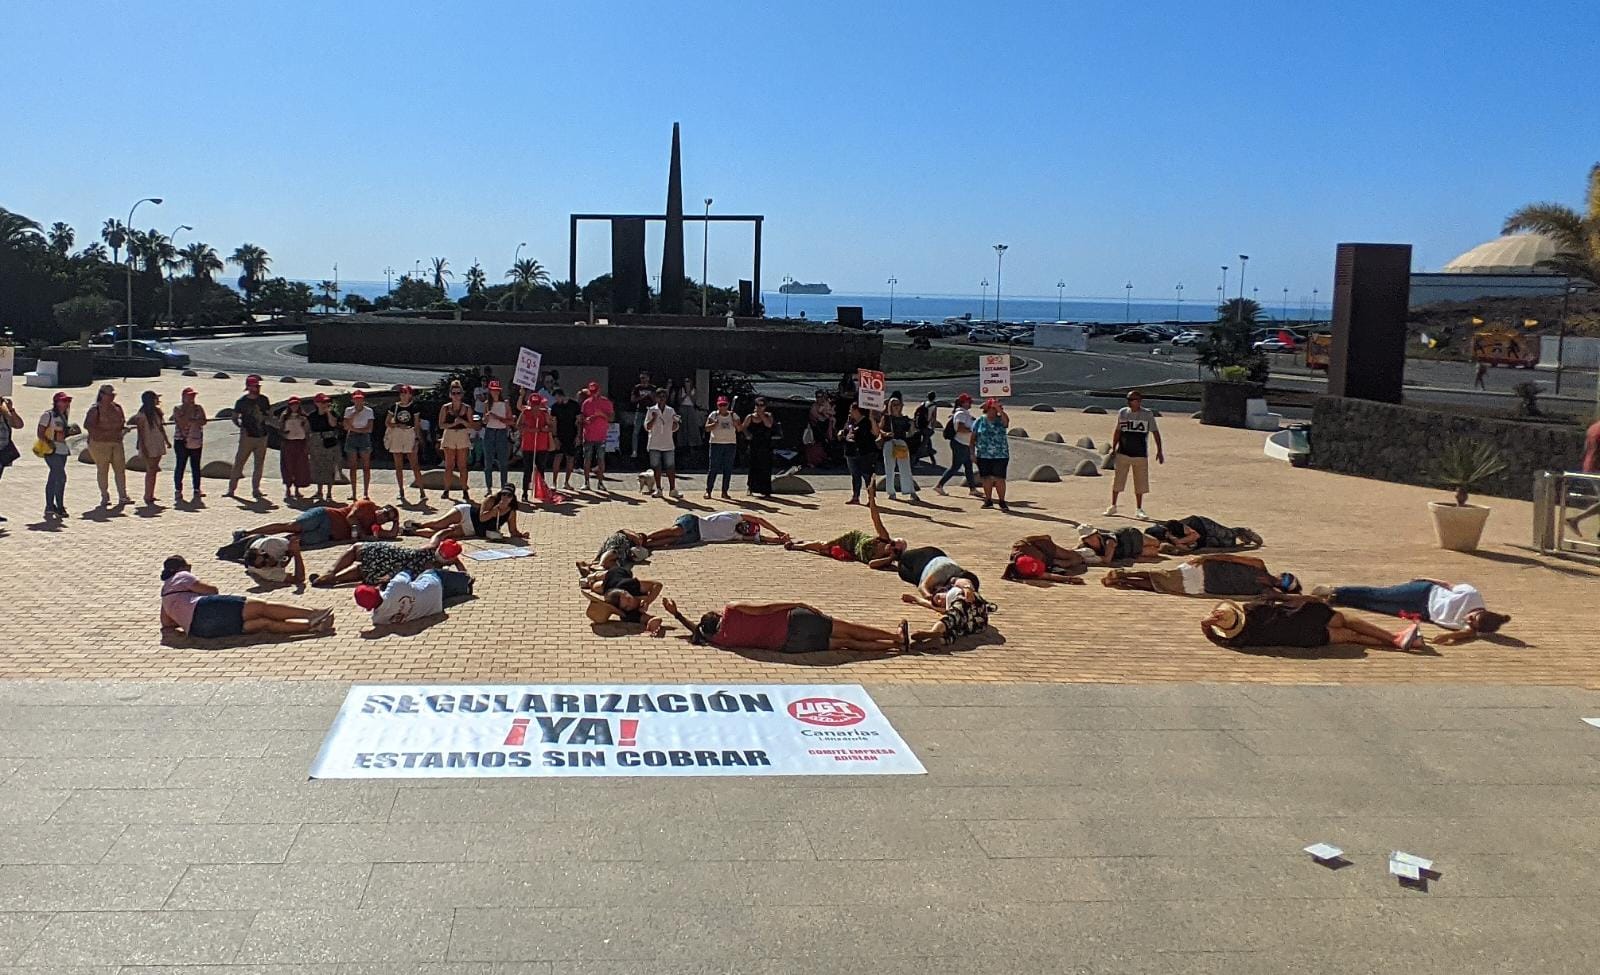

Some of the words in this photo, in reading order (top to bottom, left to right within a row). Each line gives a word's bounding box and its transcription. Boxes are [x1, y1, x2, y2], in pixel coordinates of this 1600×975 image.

[860, 376, 883, 391] NO
[1120, 421, 1146, 431] FILA
[796, 702, 863, 719] UGT
[503, 716, 639, 747] ¡YA!
[801, 729, 880, 737] Canarias
[352, 751, 531, 769] ESTAMOS
[542, 751, 606, 768] SIN
[616, 750, 771, 768] COBRAR
